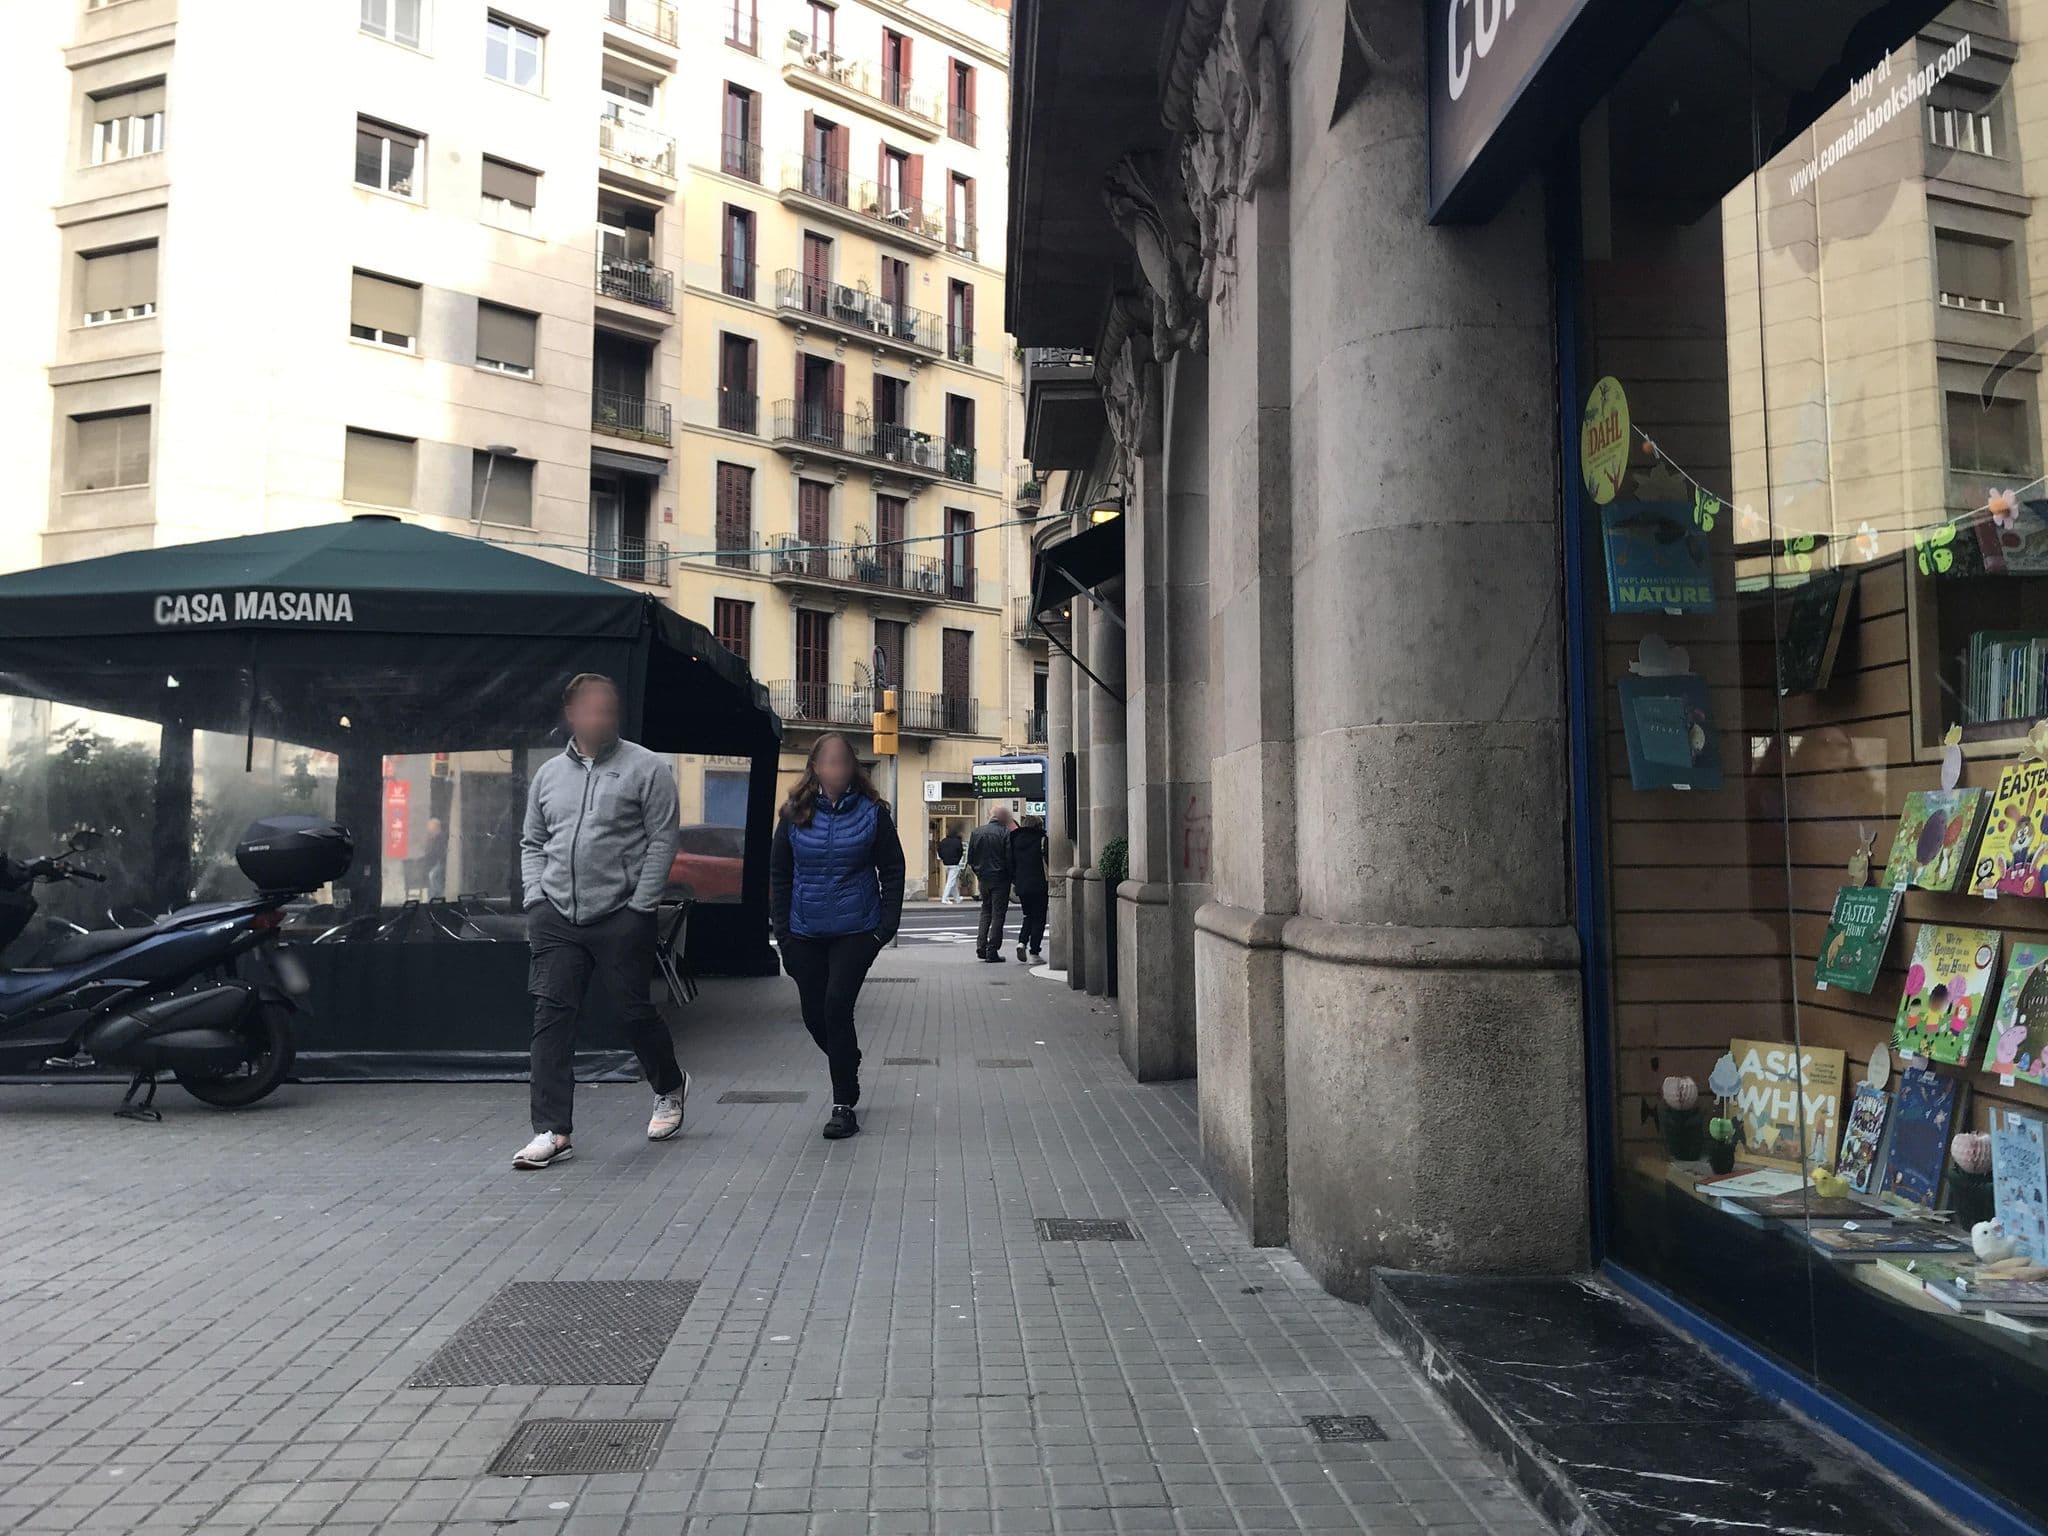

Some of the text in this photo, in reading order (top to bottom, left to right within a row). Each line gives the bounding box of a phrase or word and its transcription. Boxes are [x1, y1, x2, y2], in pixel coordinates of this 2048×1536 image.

[1850, 48, 1892, 107] buy at
[1789, 33, 1972, 196] www.comeinbookshop.com
[1588, 409, 1622, 458] DAHL
[155, 591, 353, 625] CASA MASANA
[1619, 586, 1712, 603] NATURE
[1839, 902, 1875, 926] EASTER
[1845, 924, 1867, 937] HUNT
[1738, 1048, 1812, 1085] ASK
[1737, 1085, 1836, 1128] WHY!
